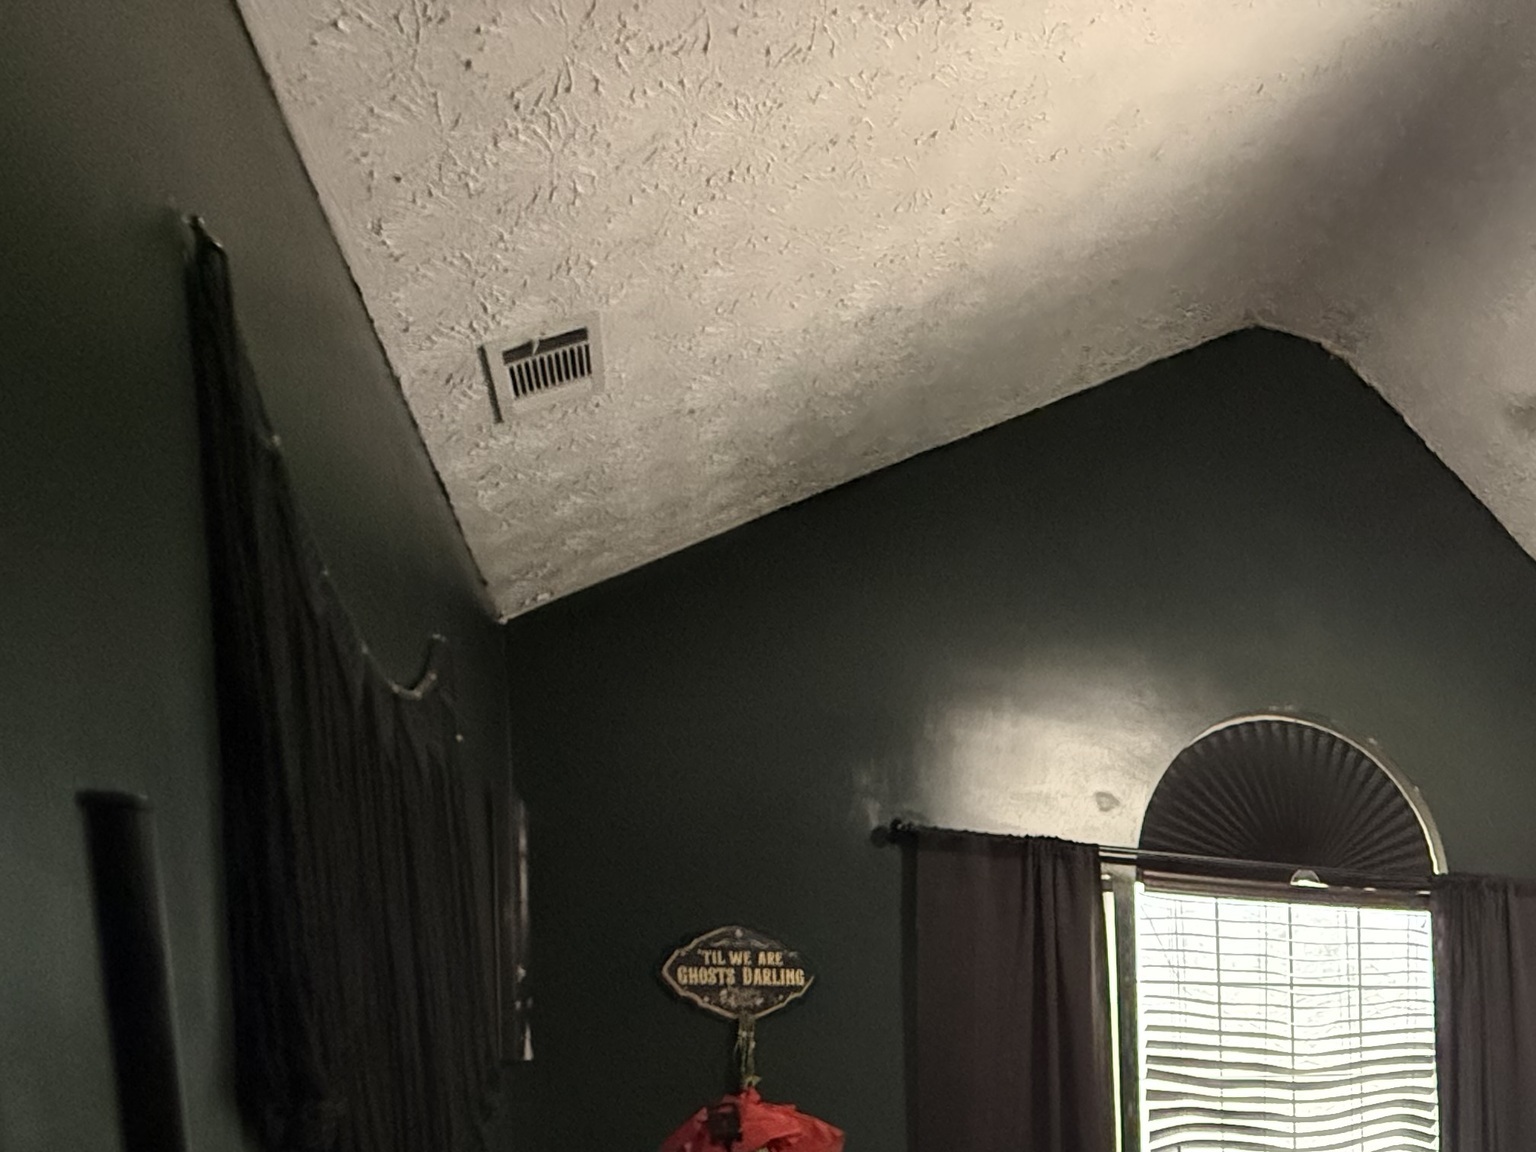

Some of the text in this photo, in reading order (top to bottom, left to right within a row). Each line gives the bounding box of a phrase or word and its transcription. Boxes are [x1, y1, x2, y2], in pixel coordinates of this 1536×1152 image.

[729, 951, 752, 965] WE
[758, 951, 784, 966] ARE
[677, 966, 805, 987] GHOSTS DARLING
